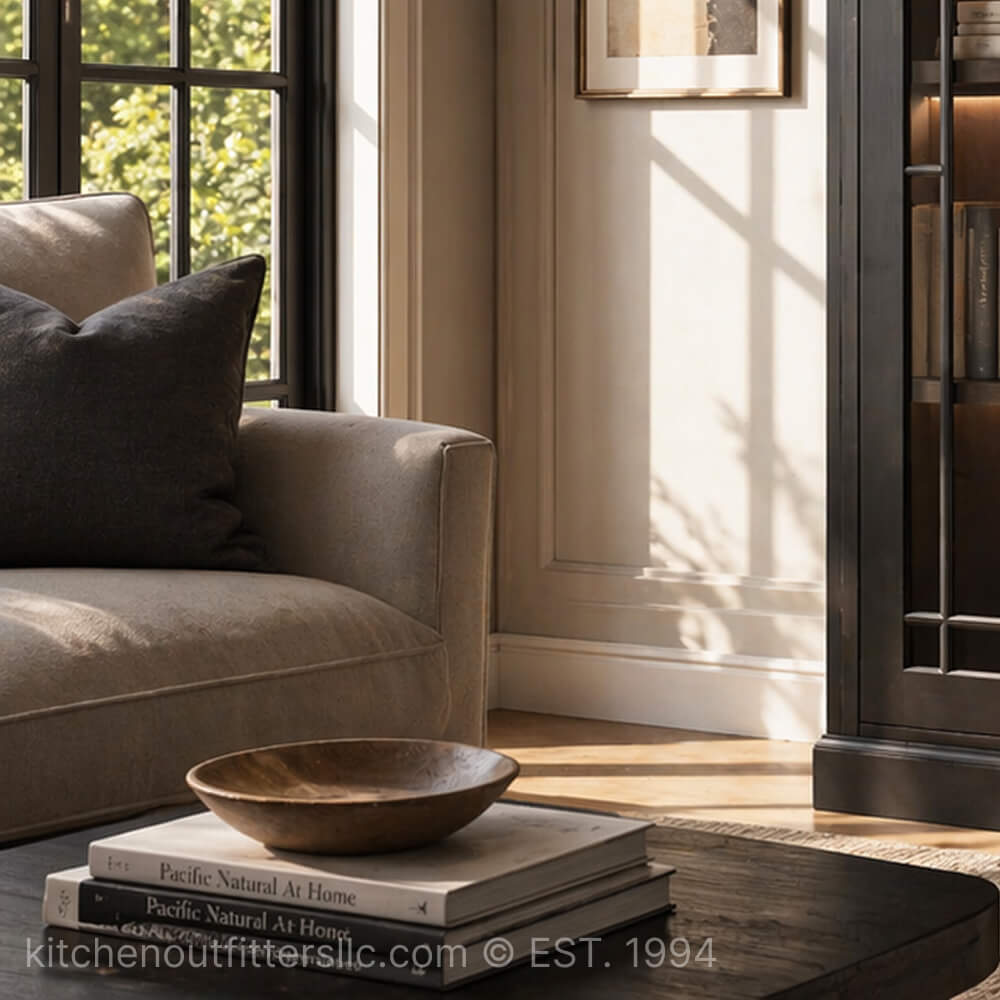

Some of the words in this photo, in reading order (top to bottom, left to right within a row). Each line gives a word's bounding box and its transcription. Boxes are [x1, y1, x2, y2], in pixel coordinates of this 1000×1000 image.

[159, 862, 212, 887] Pacific
[216, 869, 277, 896] Natural
[282, 880, 301, 899] At
[308, 881, 357, 907] Home
[146, 895, 201, 921] Pacific
[205, 903, 267, 930] Natural
[272, 915, 296, 934] At
